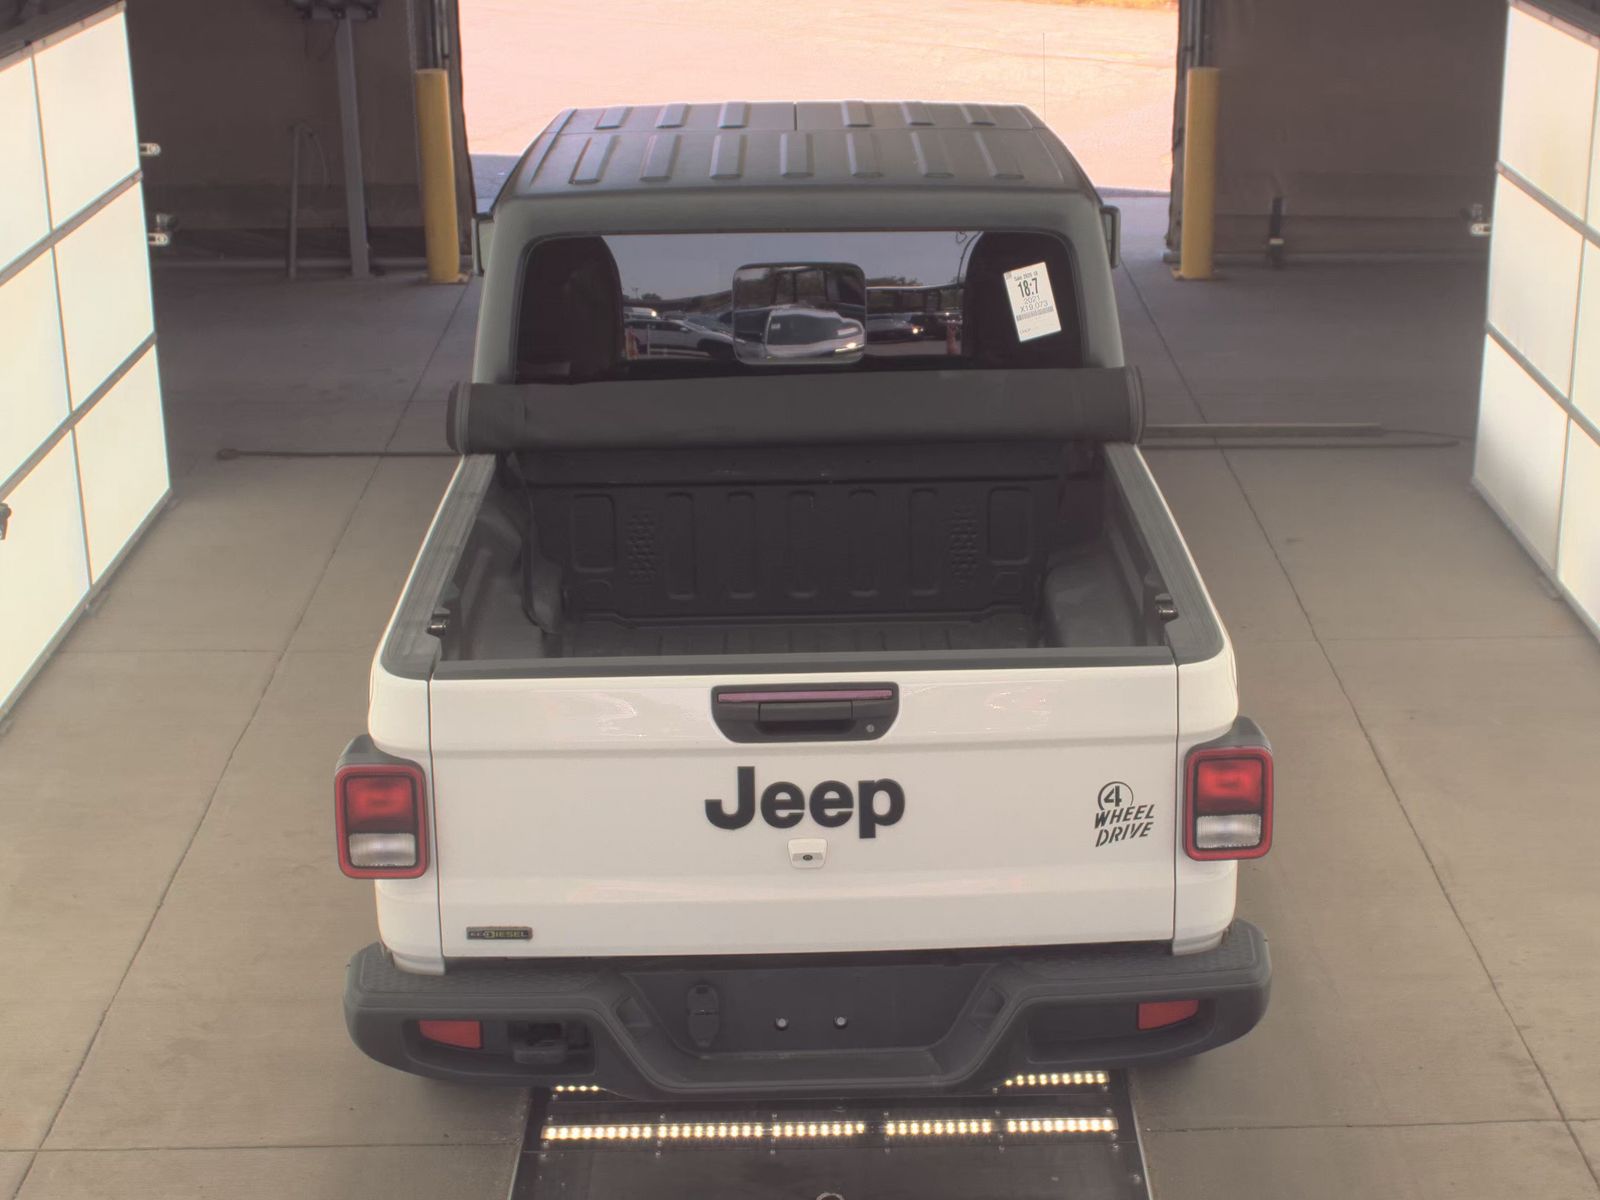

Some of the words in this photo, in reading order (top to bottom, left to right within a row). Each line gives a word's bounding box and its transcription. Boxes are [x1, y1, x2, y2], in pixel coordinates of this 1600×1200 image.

[1018, 277, 1039, 298] 18:7
[704, 765, 906, 840] Jeep
[1103, 785, 1122, 808] 4
[1094, 804, 1155, 829] WHEEL
[1095, 821, 1155, 848] DRIVE
